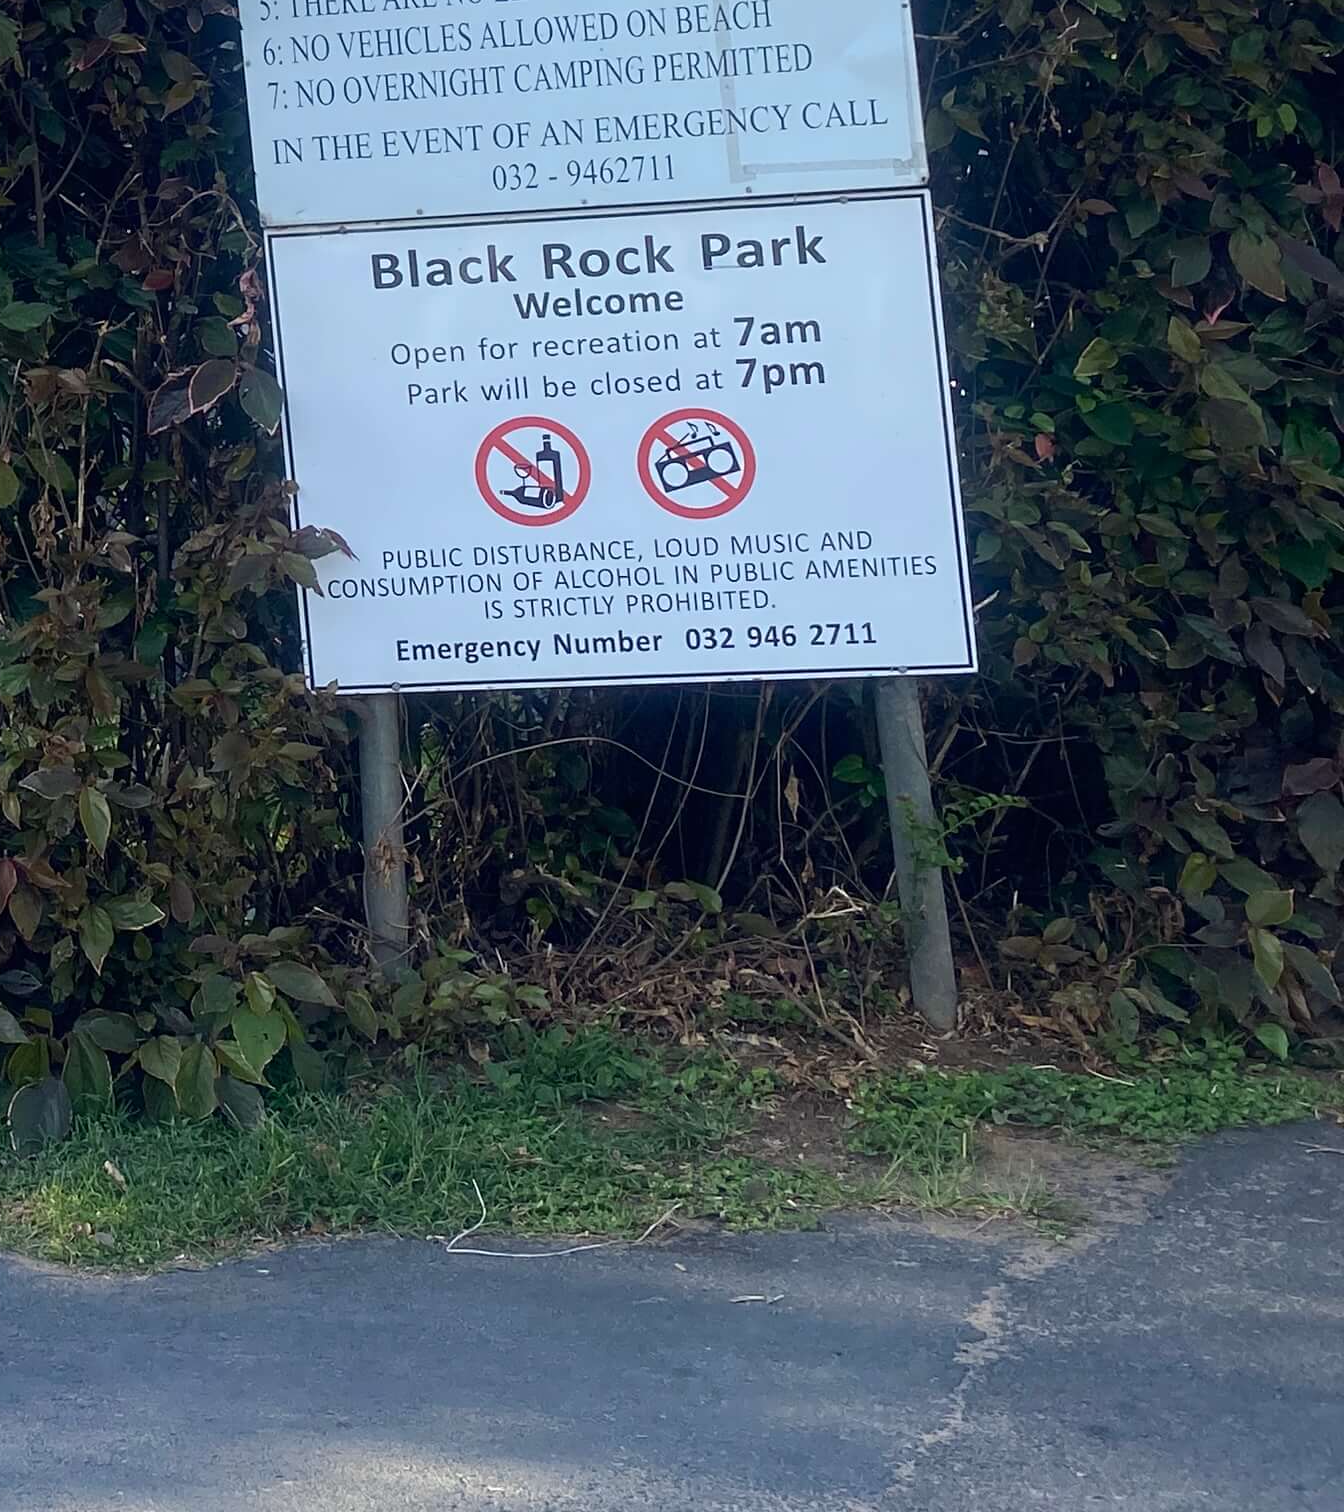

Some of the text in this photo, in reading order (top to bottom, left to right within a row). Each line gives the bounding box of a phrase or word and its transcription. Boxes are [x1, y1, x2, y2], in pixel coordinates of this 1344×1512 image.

[264, 0, 771, 65] 6: NO VEHICLES ALLOWED ON BEACH
[268, 44, 811, 109] 7: NO OVERNIGHT CAMPING PERMITTED
[273, 99, 888, 164] IN THE EVENT OF AN EMERGENCY CALL
[493, 163, 538, 190] 032
[567, 154, 673, 186] 9462711
[372, 226, 826, 289] Black Rock Park
[513, 288, 683, 319] Welcome
[392, 317, 821, 369] Open for recreation at 7am
[408, 358, 825, 405] Park will be closed at 7pm
[383, 531, 872, 570] PUBLIC DISTURBANCE, LOUD MUSIC AND
[328, 556, 936, 598] CONSUMPTION OF ALCOHOL IN PUBLIC AMENITIES
[485, 590, 775, 619] IS STRICTLY PROHIBITED.
[397, 622, 877, 663] Emergency Number 032 946 2711
